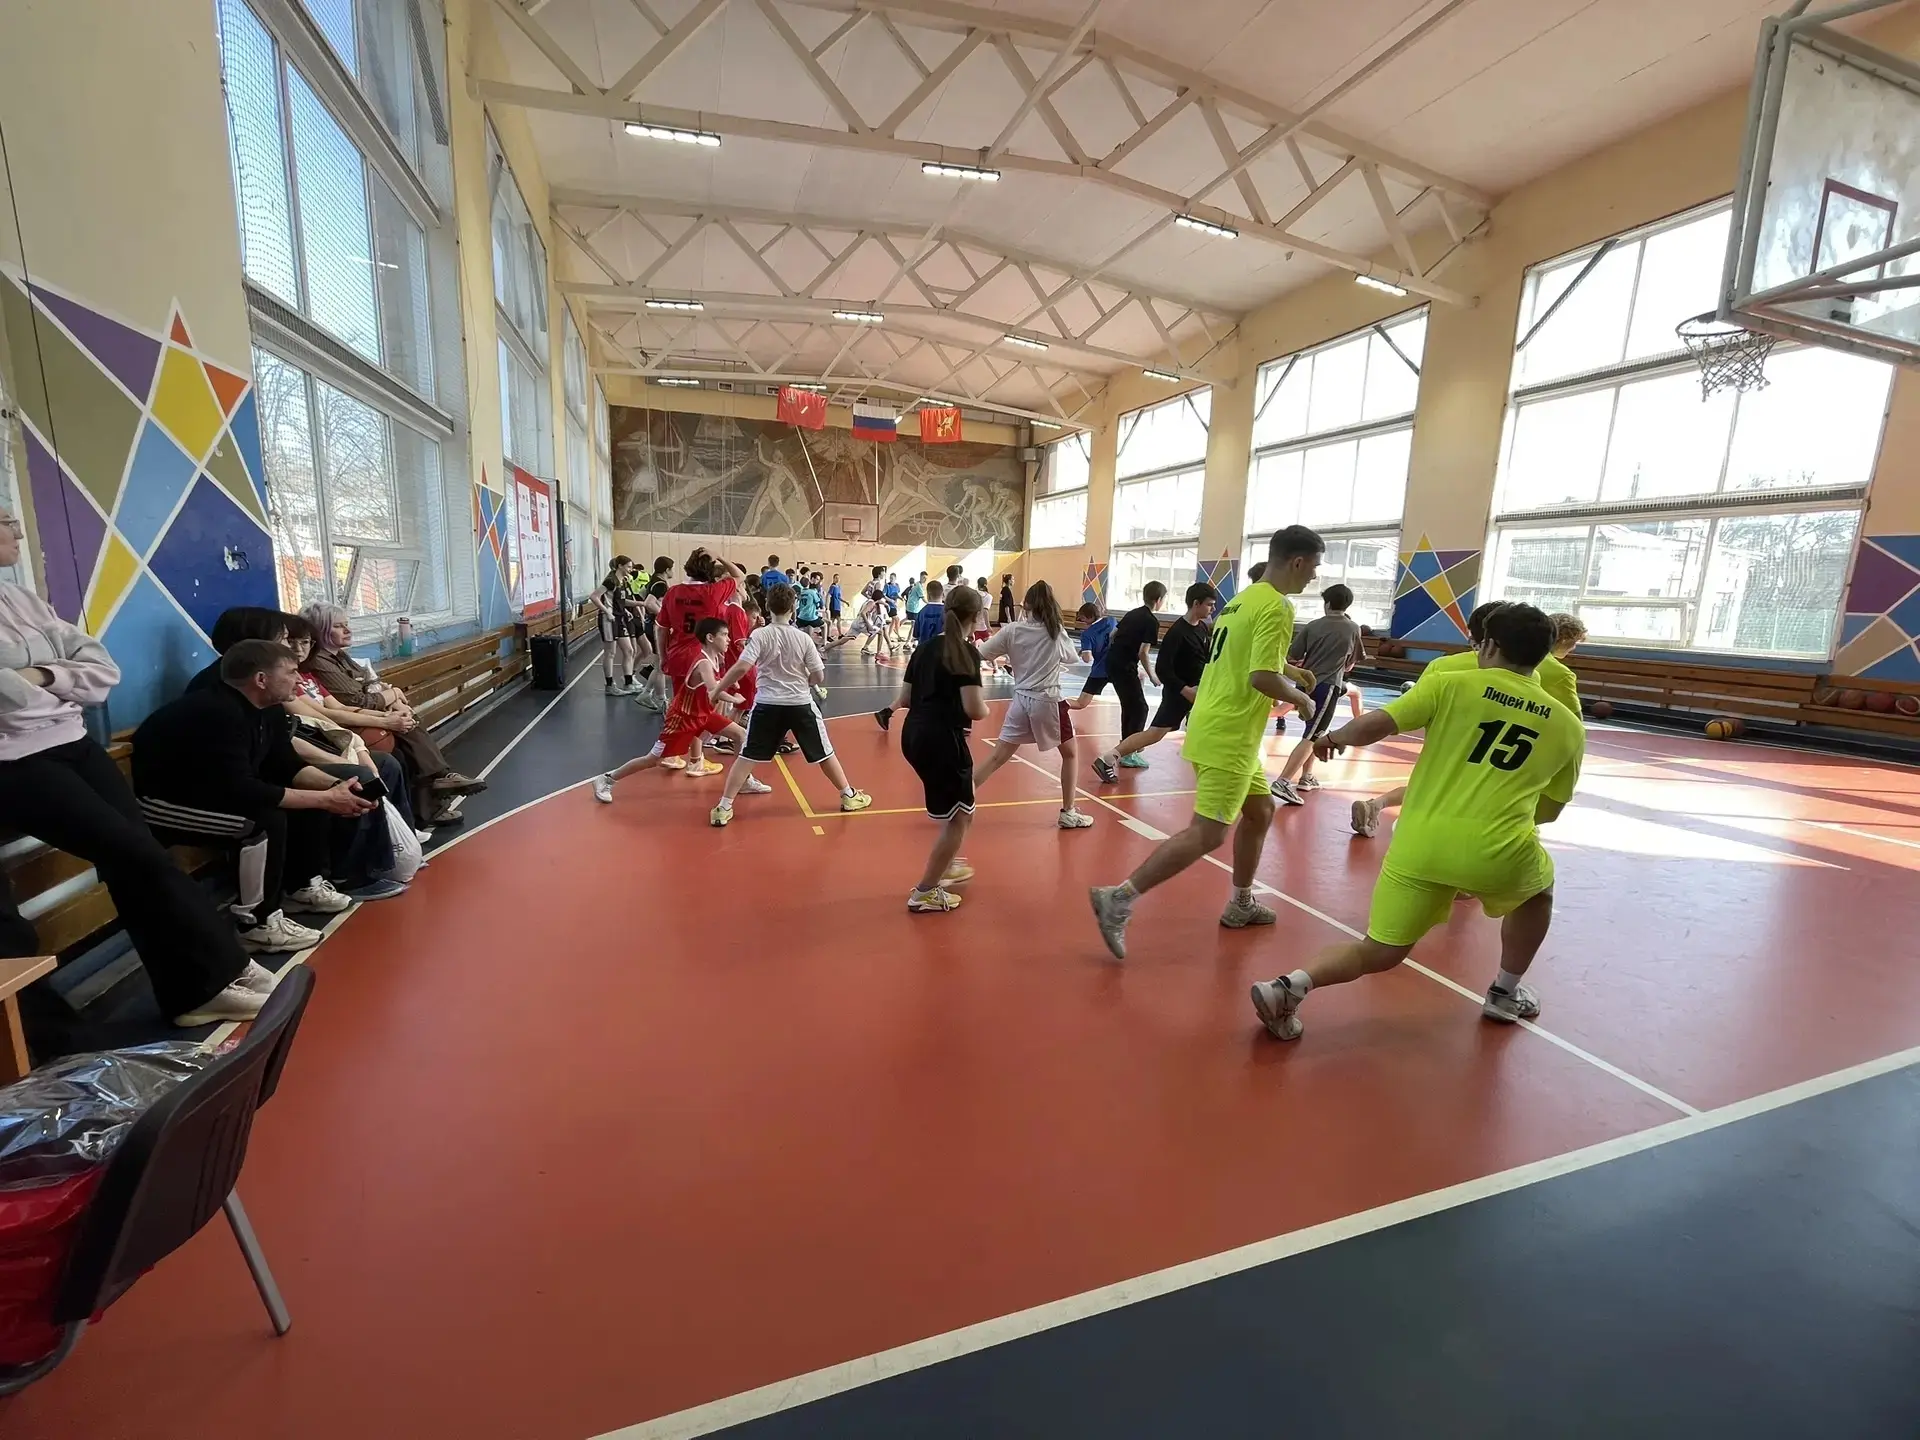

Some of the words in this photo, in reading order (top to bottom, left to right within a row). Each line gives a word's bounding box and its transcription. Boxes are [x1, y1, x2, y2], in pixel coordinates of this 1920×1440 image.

[1482, 686, 1524, 710] Лицей
[1525, 700, 1552, 719] №14
[1467, 719, 1540, 771] 15
